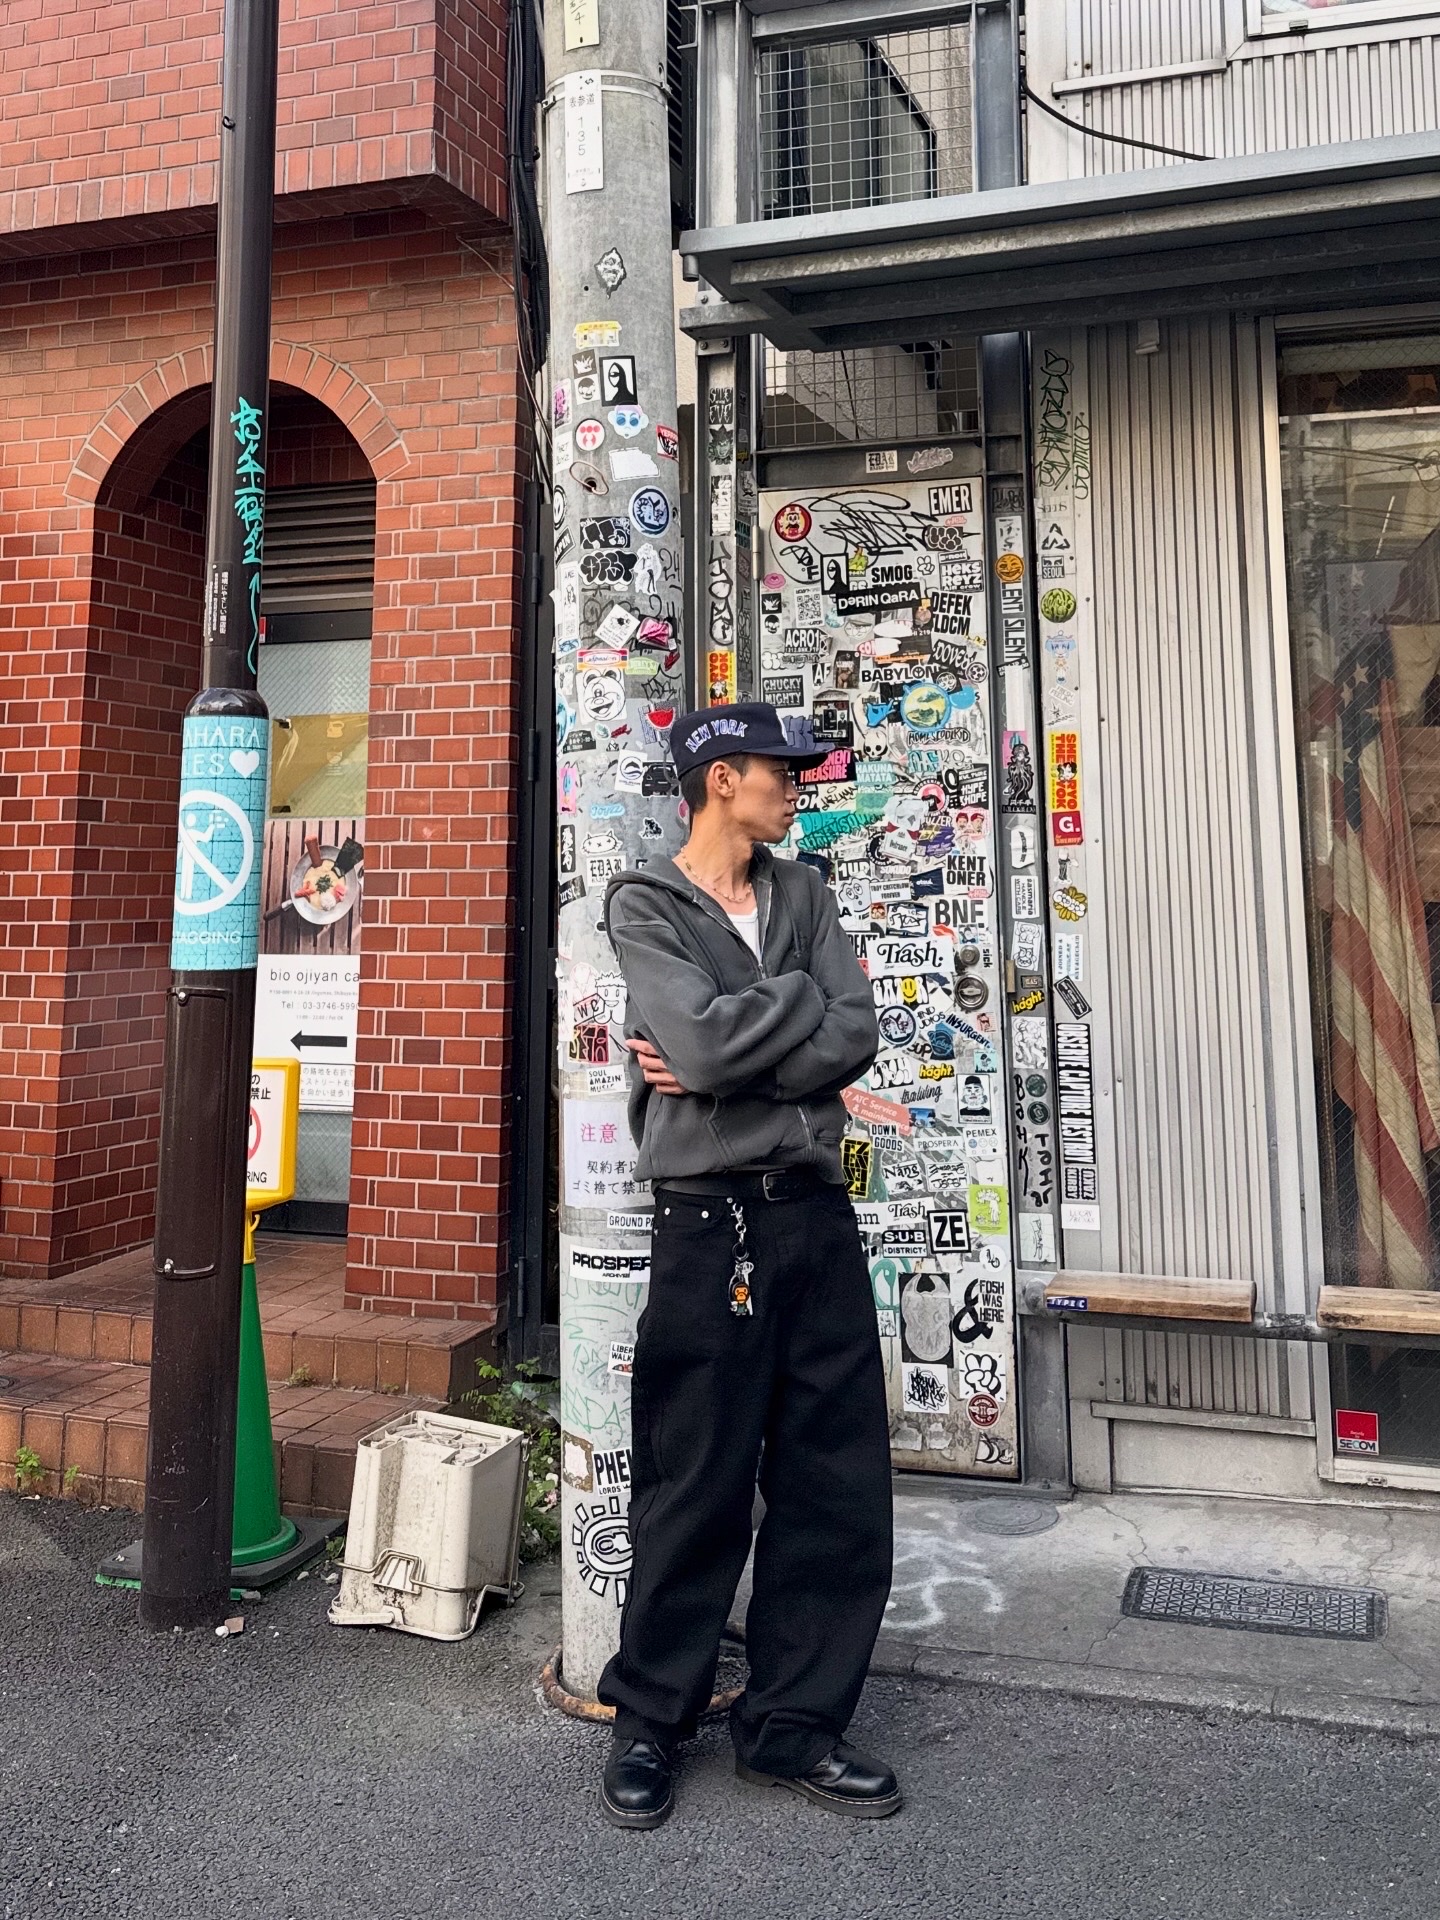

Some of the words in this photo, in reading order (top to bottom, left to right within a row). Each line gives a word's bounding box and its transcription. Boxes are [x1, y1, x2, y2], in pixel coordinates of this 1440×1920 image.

[932, 485, 971, 515] EMER
[871, 564, 913, 583] SMOG
[1043, 566, 1064, 578] SEOUL
[1001, 579, 1024, 613] LENT
[1004, 618, 1026, 661] SILENT
[763, 677, 802, 691] CHUCKY
[764, 690, 802, 707] MIGHTY
[685, 723, 712, 754] NEW
[710, 718, 750, 738] YORK
[799, 764, 849, 783] TREASURE
[1056, 779, 1067, 810] YOK
[1067, 778, 1079, 810] RYO
[946, 855, 987, 871] KENT
[946, 869, 987, 887] ONER
[270, 968, 291, 982] bio
[296, 968, 338, 985] ojiyan
[281, 1000, 294, 1009] Tel
[1056, 1023, 1090, 1068] OBSERVE
[588, 1069, 607, 1078] SOUL
[1059, 1069, 1093, 1116] CAPTURE
[852, 1093, 869, 1107] ATC
[868, 1098, 899, 1117] Service
[580, 1122, 618, 1144] 注意
[870, 1123, 898, 1136] DOWN
[965, 1127, 998, 1138] PEMEX
[873, 1136, 903, 1151] GOODS
[1062, 1117, 1095, 1164] DESTROY
[572, 1180, 651, 1195] ゴミ捨て禁止
[1066, 1168, 1079, 1199] KIRBY
[608, 1214, 645, 1228] GROUND
[932, 1215, 966, 1248] ZE
[979, 1279, 1005, 1294] FOSH
[981, 1294, 1003, 1308] WAS
[1078, 1299, 1086, 1309] C
[979, 1308, 1005, 1323] HERE
[611, 1352, 633, 1363] WALK
[1339, 1440, 1376, 1453] SECOM
[598, 1485, 621, 1495] LORDS
